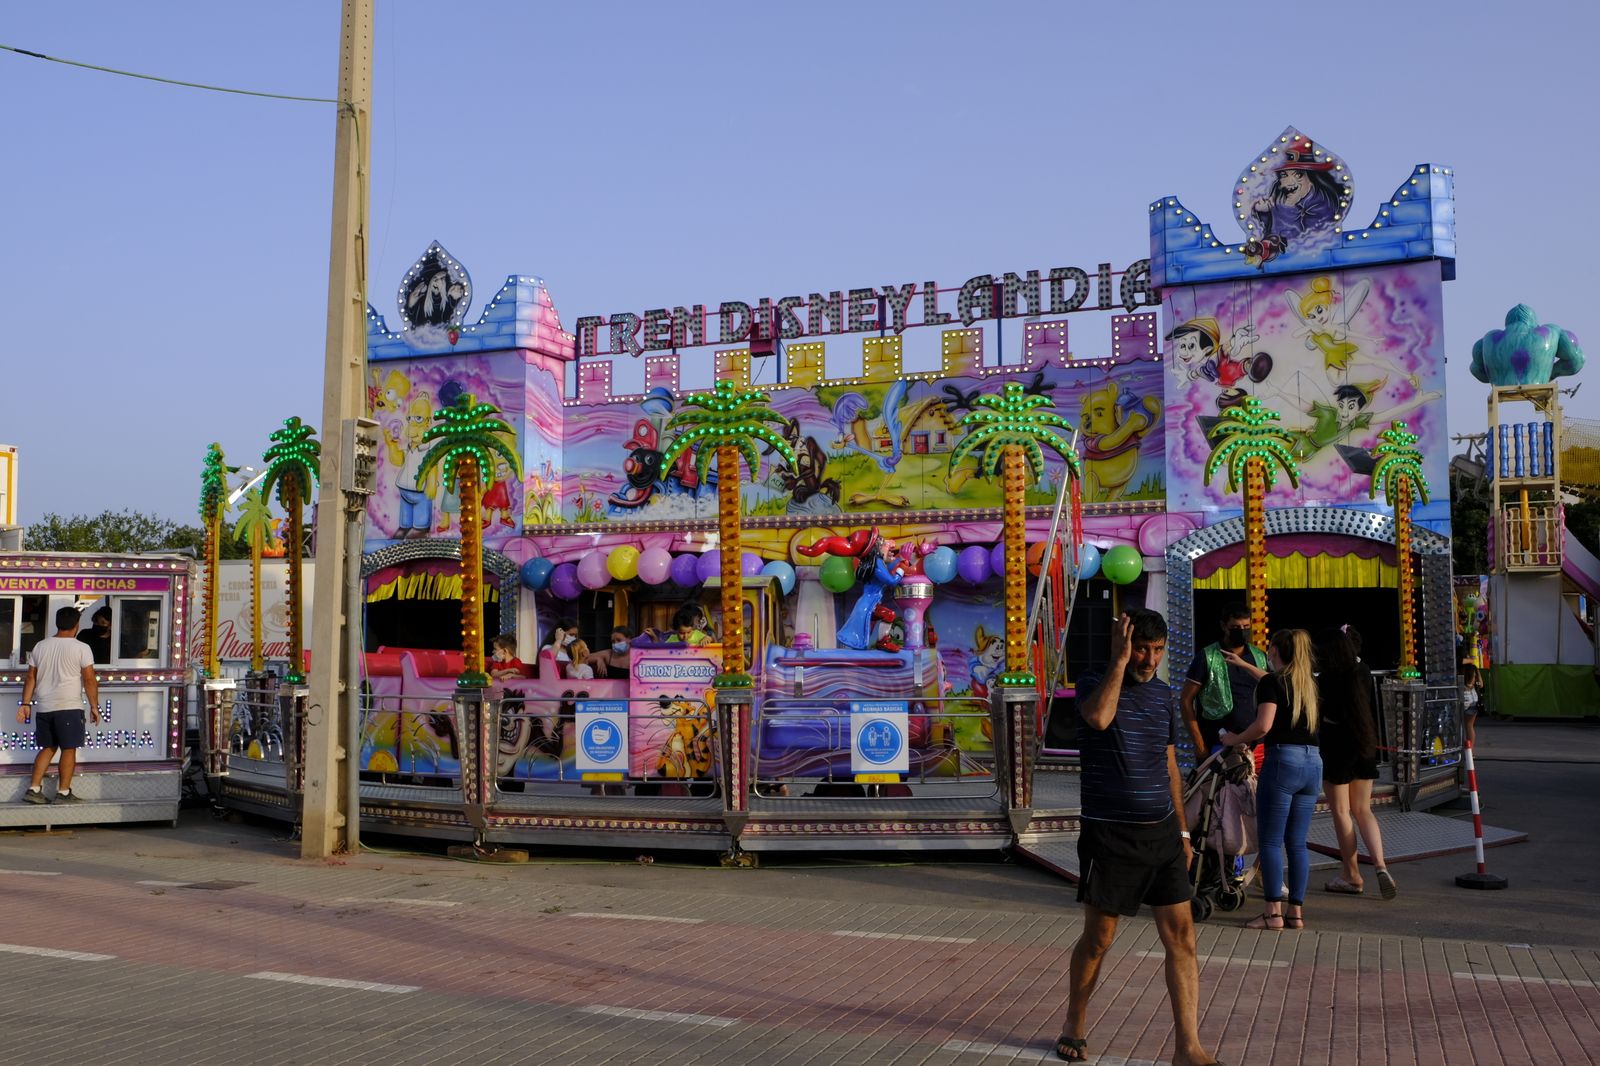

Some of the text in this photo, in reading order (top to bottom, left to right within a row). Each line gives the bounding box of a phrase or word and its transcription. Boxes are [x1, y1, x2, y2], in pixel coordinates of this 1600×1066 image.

[577, 258, 1162, 358] TREN DISNEYLANDIA
[0, 578, 137, 590] VENTA DE FICHAS
[638, 664, 673, 678] UNION
